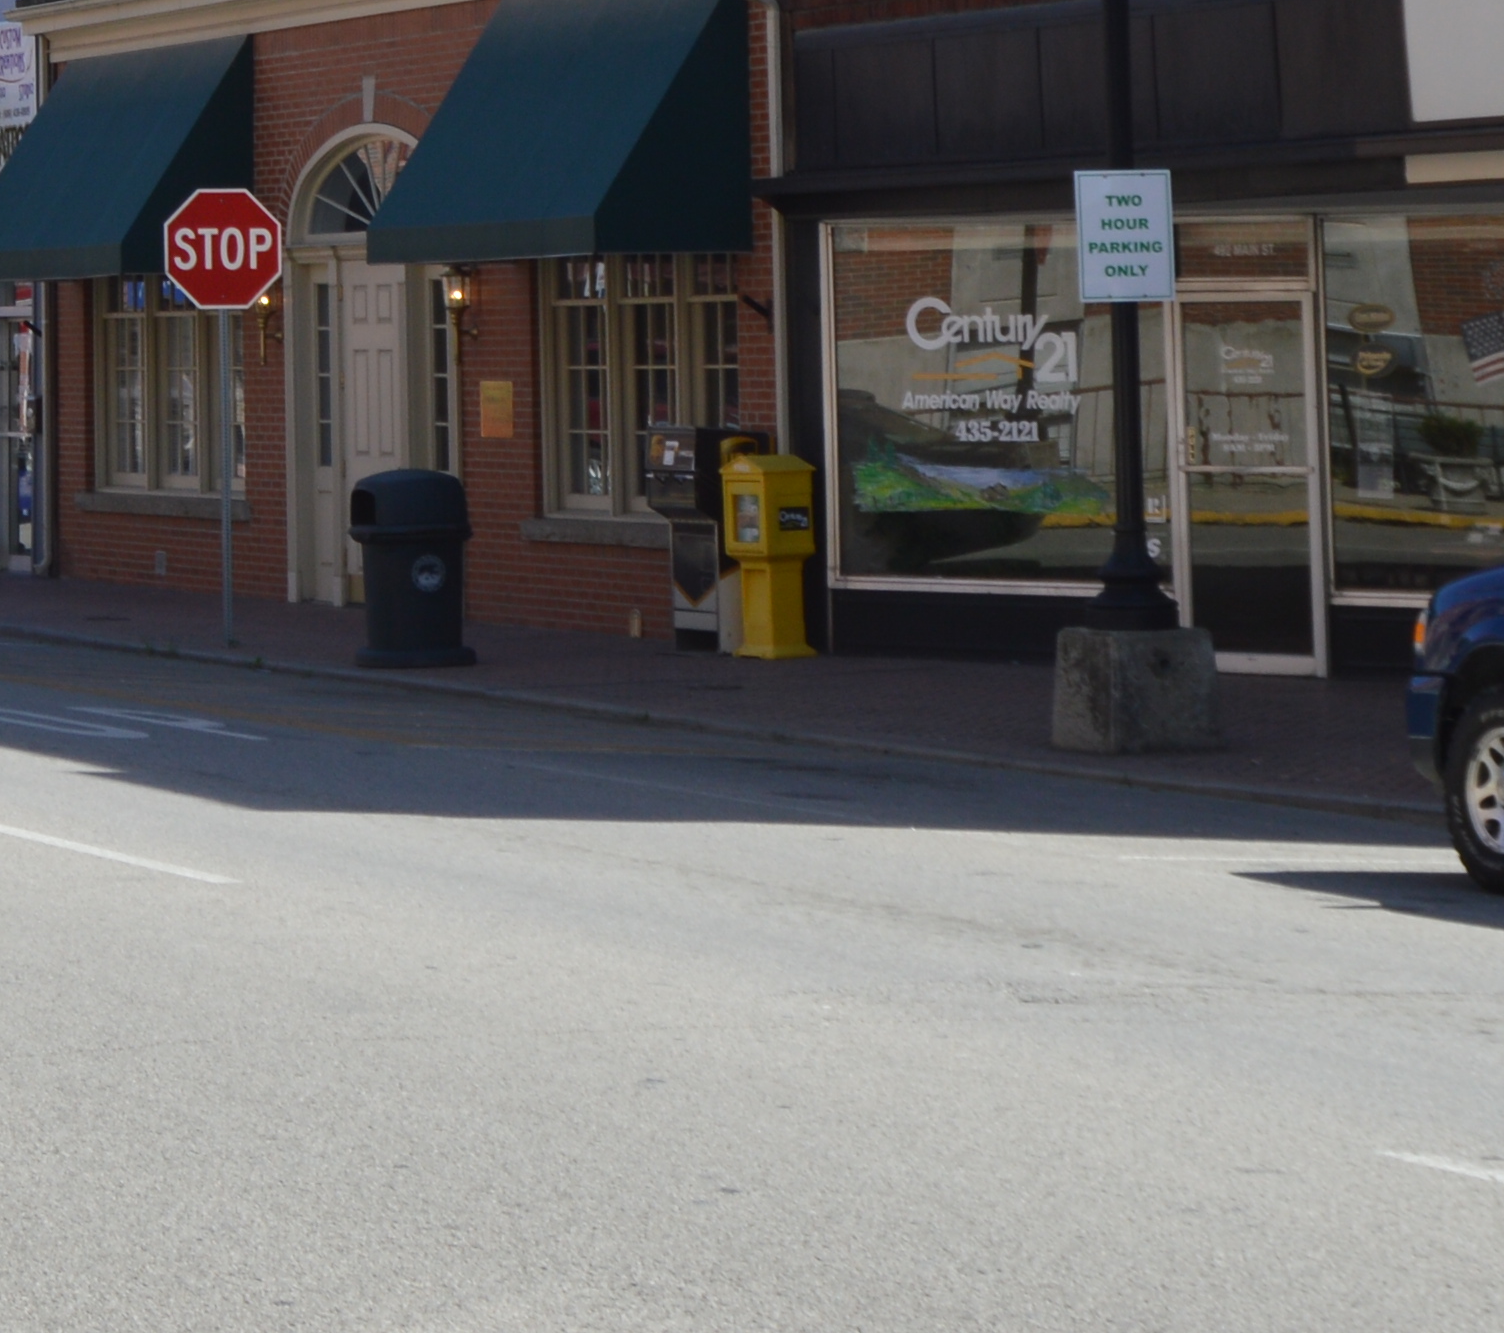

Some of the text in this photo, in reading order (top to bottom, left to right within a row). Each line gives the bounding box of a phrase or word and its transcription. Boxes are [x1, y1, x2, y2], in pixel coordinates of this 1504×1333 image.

[1105, 195, 1142, 207] TWO
[1101, 218, 1149, 230] HOUR
[174, 227, 273, 271] STOP
[1088, 241, 1163, 253] PARKING
[1104, 265, 1148, 277] ONLY
[906, 296, 1050, 351] Century
[1034, 331, 1078, 382] 21
[902, 390, 1082, 414] American Way Realty
[955, 420, 1040, 442] 435-2121
